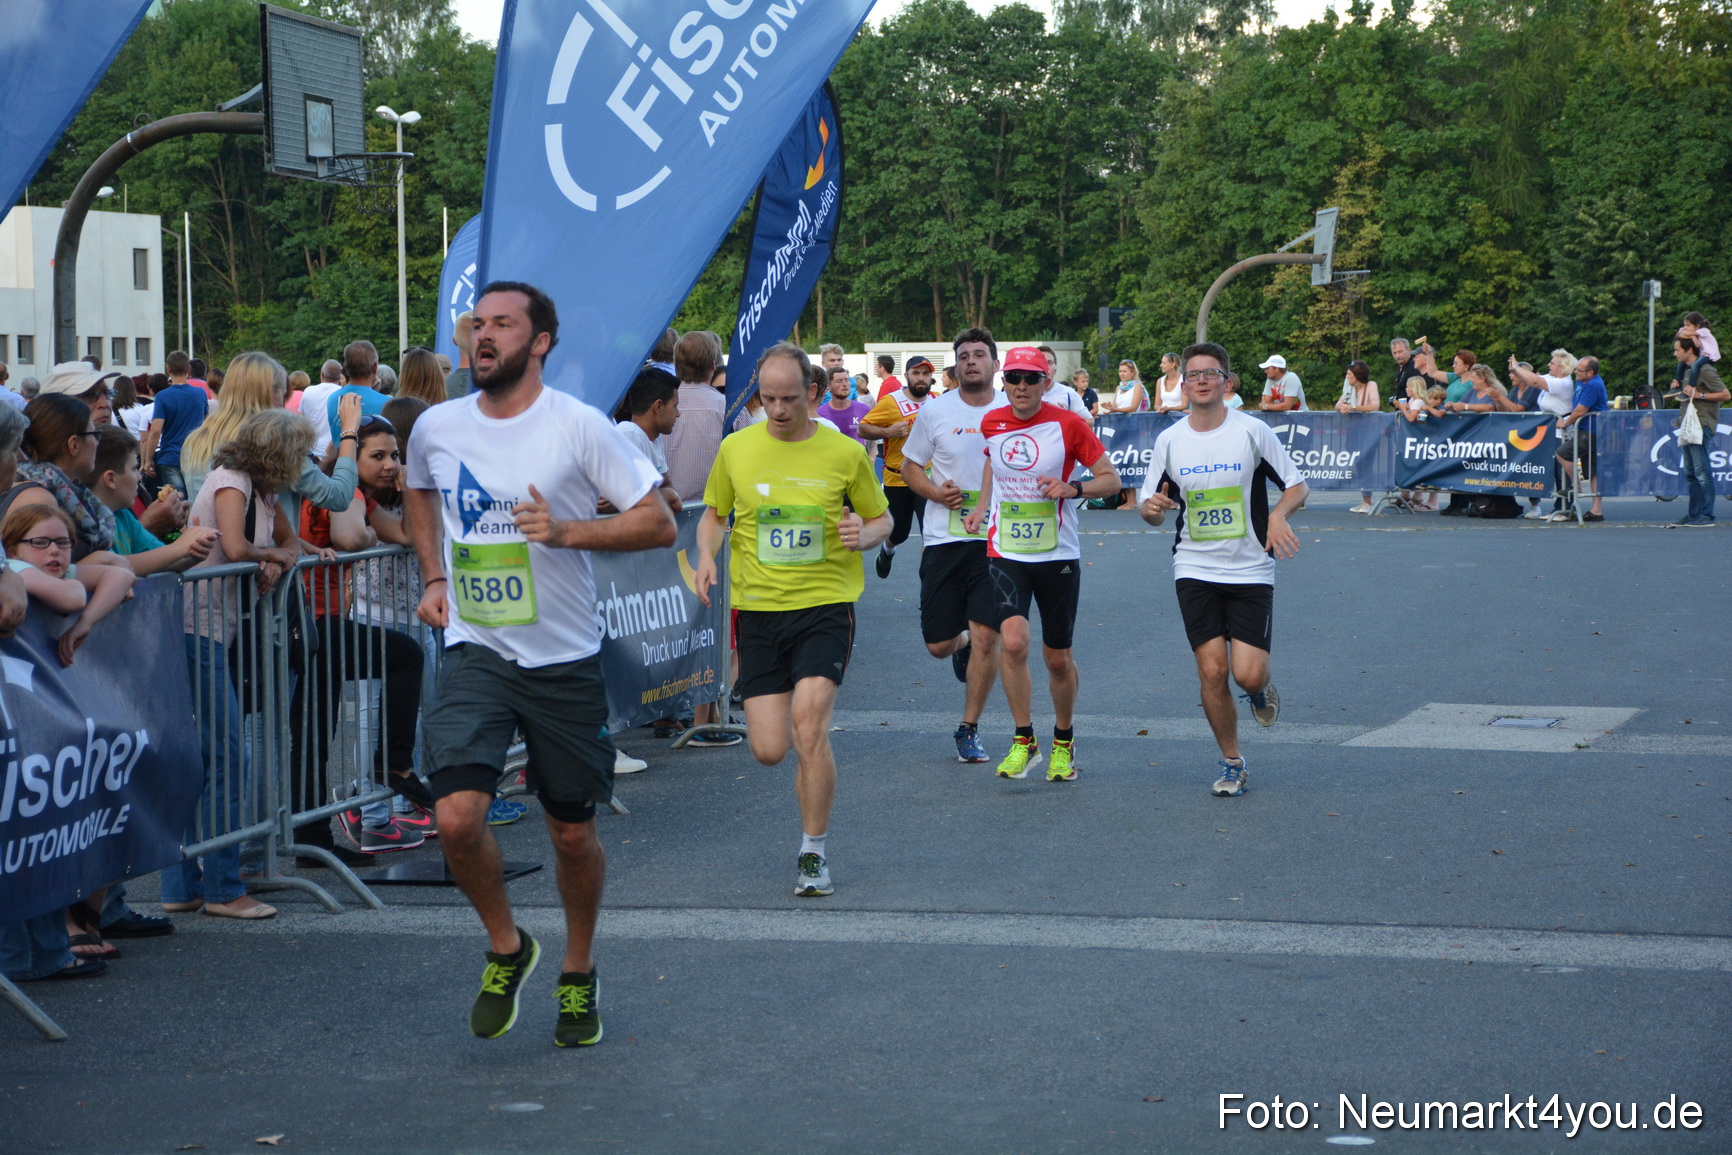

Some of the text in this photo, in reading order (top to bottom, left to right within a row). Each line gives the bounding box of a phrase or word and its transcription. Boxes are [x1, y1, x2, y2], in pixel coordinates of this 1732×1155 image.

[738, 198, 811, 356] Frischmann
[1282, 444, 1361, 467] ischer
[1404, 437, 1508, 460] Frischmann
[1180, 463, 1242, 476] DELPHI
[1462, 460, 1546, 475] Druck und Medien
[470, 519, 518, 534] Team
[1197, 508, 1234, 527] 288
[770, 528, 812, 549] 615
[1011, 522, 1045, 539] 537
[459, 574, 524, 604] 1580
[641, 636, 671, 667] Druck
[671, 630, 689, 659] und
[0, 717, 150, 822] ischer
[0, 803, 131, 876] UTOMOBILE
